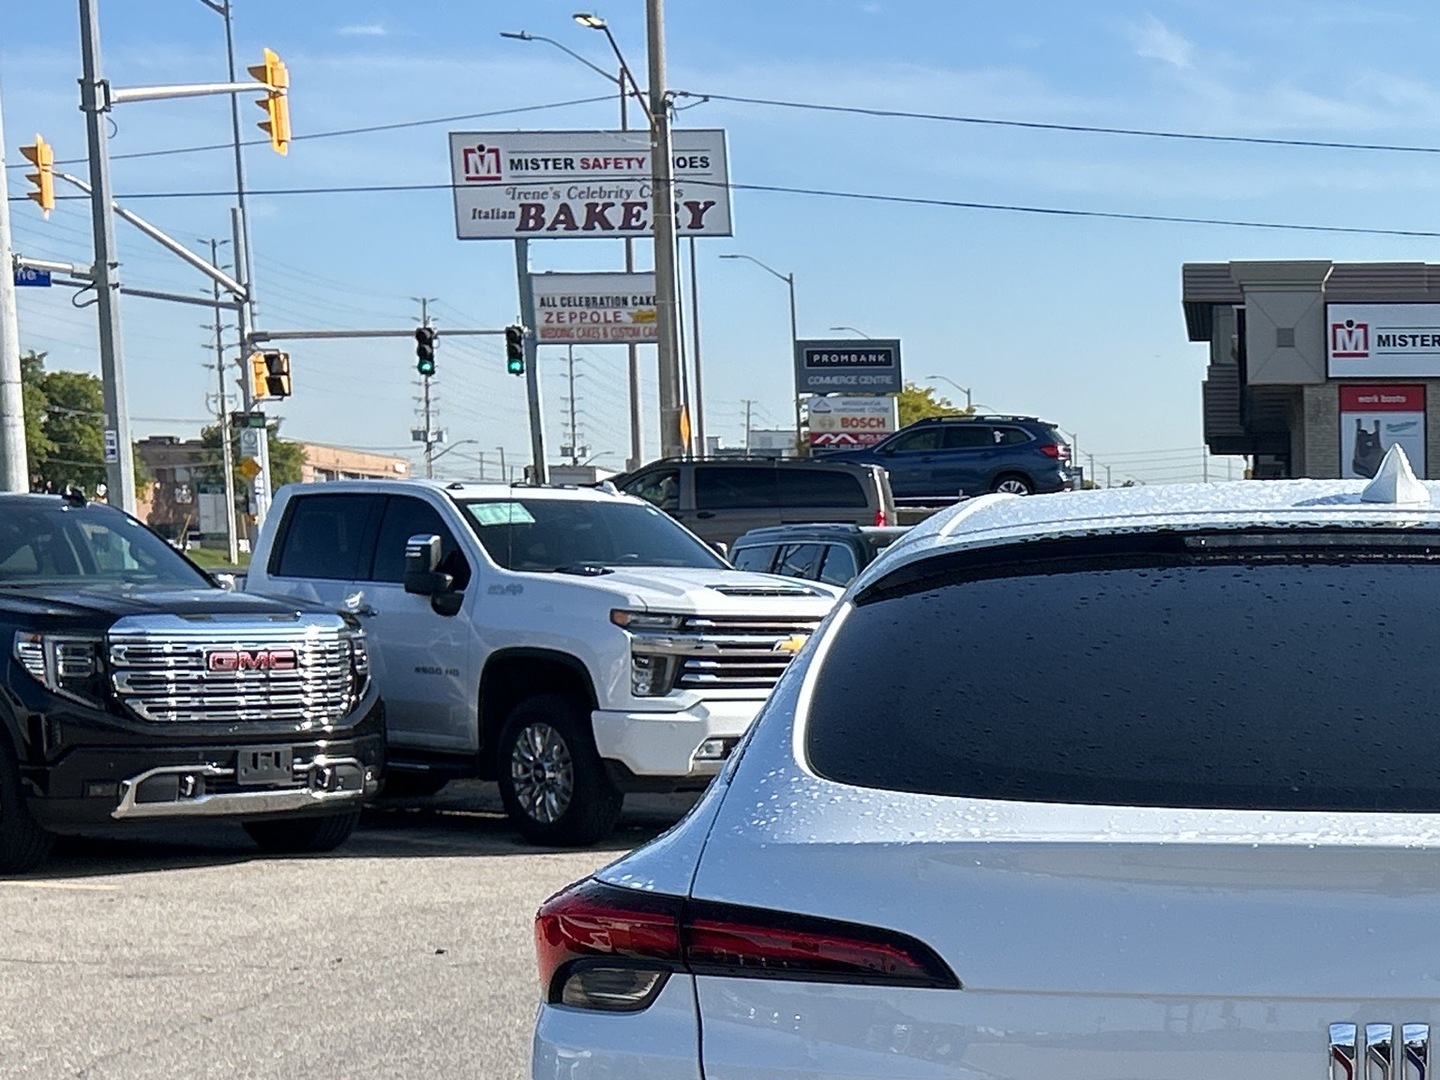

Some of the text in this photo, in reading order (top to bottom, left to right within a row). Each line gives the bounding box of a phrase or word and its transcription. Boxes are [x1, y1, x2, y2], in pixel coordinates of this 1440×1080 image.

[509, 157, 575, 171] MISTER
[580, 157, 646, 170] SAFETY
[505, 186, 561, 200] Irene's
[567, 185, 634, 200] Celebrity
[471, 208, 516, 220] Italian
[539, 297, 557, 308] ALL
[560, 296, 628, 308] CELEBRATION
[544, 311, 623, 324] ZEPPOLE
[812, 353, 886, 363] PROMBANK
[807, 375, 893, 385] COMMERCE CENTRE
[840, 417, 886, 429] BOSCH
[209, 651, 295, 670] GMC
